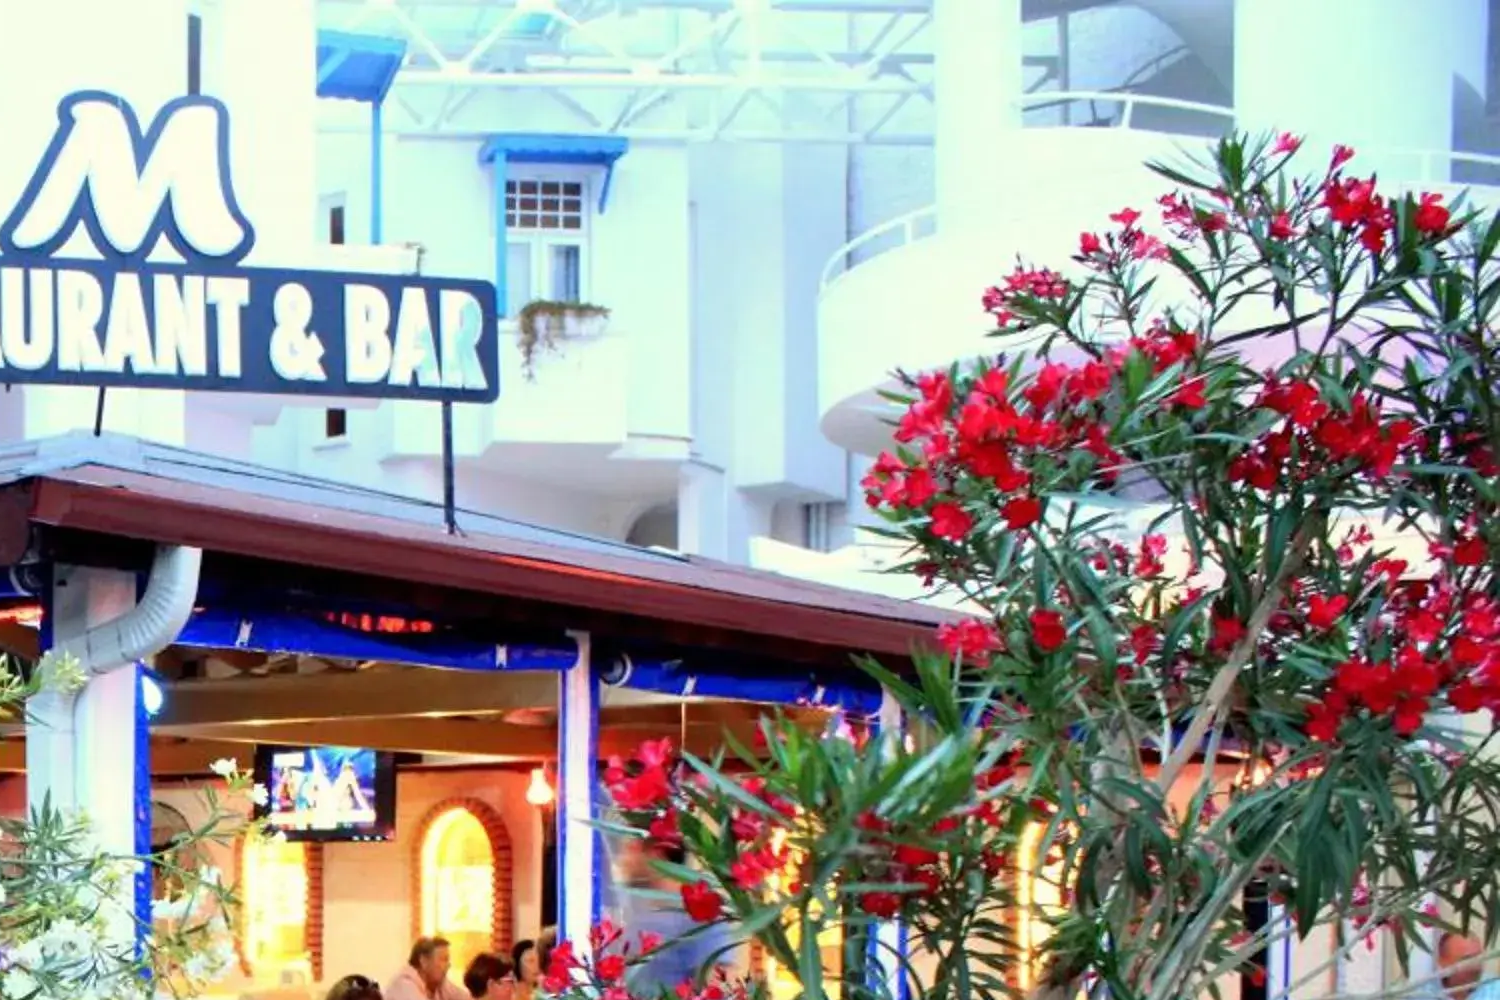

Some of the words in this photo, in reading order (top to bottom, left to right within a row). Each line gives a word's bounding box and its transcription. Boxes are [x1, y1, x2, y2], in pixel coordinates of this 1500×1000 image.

[8, 96, 250, 258] M
[269, 284, 326, 382] &
[345, 286, 488, 391] BAR
